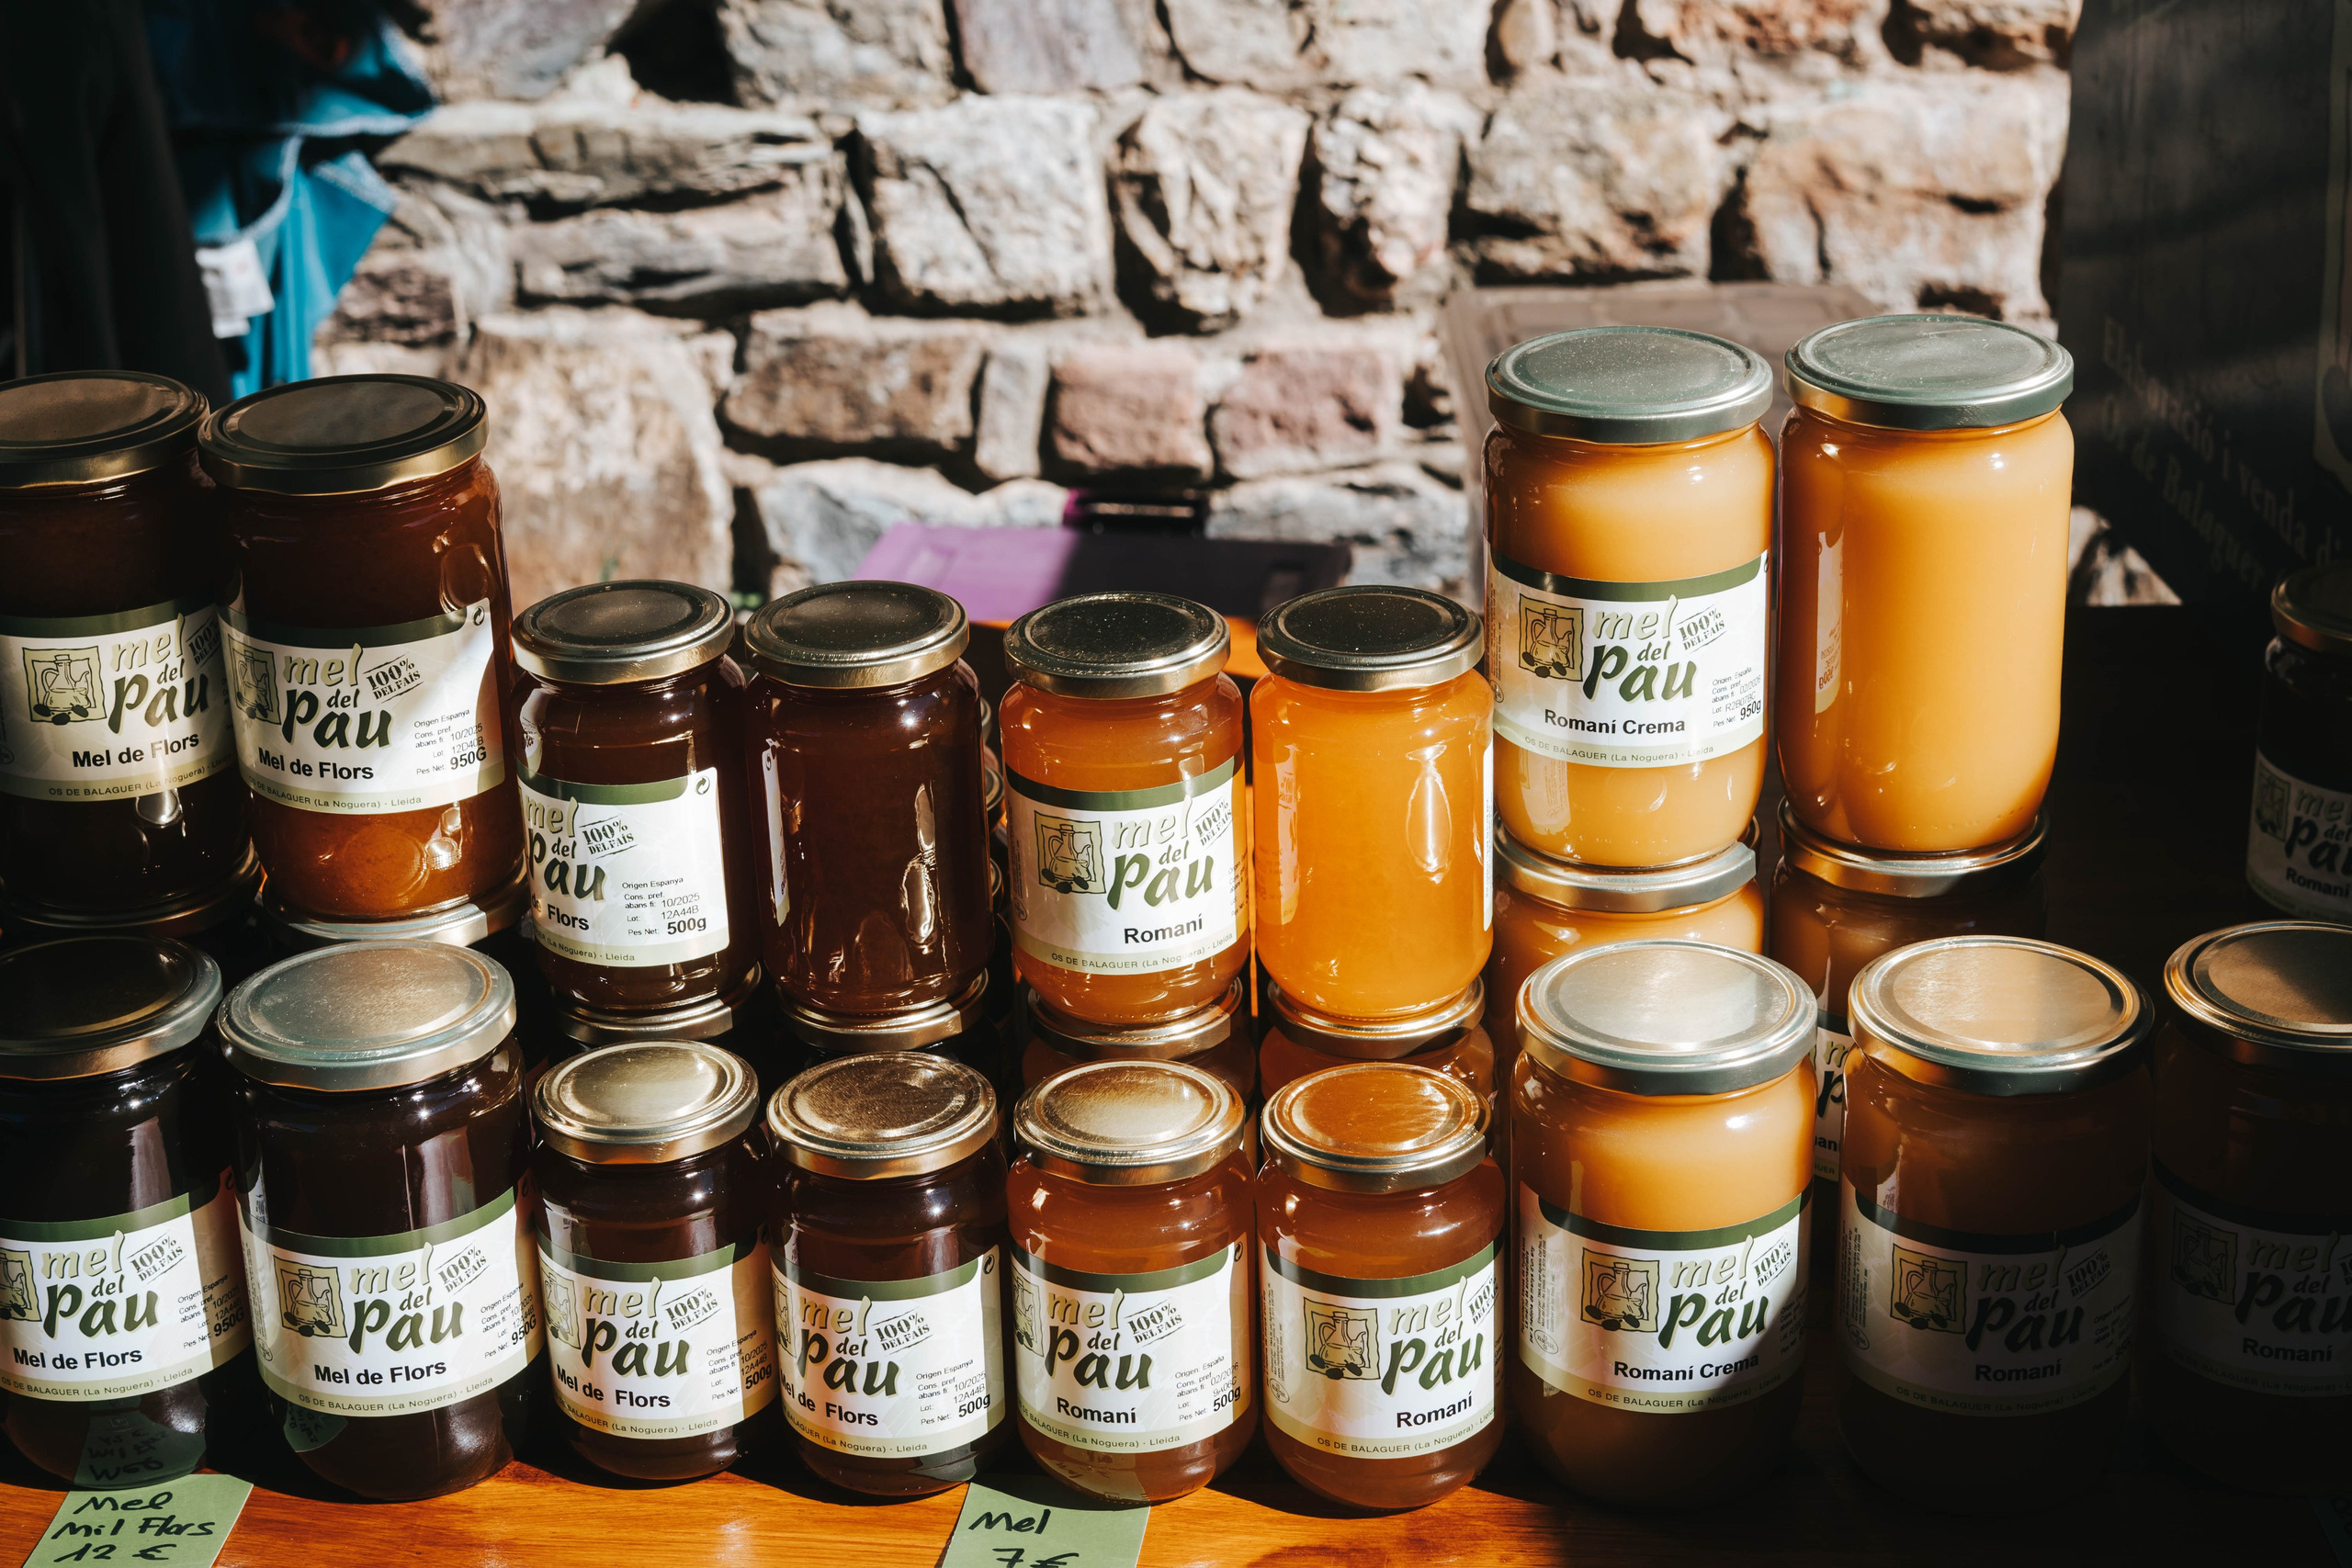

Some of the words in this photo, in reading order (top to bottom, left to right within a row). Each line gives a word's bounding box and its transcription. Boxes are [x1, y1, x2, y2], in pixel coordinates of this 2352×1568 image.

[1591, 594, 1679, 640] mel
[1678, 607, 1723, 641] 100%
[110, 613, 185, 671] mel
[1636, 640, 1671, 661] del
[157, 659, 185, 683] del
[283, 643, 363, 686] mel
[367, 657, 415, 691] 100%
[327, 688, 360, 708] del
[1740, 698, 1762, 721] 950g
[451, 723, 483, 741] 10/2025
[1544, 709, 1617, 735] Romaní
[1622, 720, 1686, 735] Crema
[73, 750, 111, 768] Mel
[119, 747, 144, 764] de
[151, 734, 199, 759] Flors
[450, 746, 488, 770] 950G
[1525, 736, 1536, 747] OS
[1538, 740, 1551, 750] DE
[1553, 745, 1607, 761] BALAGUER
[1631, 751, 1679, 762] Noguera)
[257, 747, 285, 771] Mel
[289, 759, 313, 777] de
[320, 761, 374, 780] Flors
[49, 787, 62, 795] OS
[66, 787, 80, 796] DE
[84, 784, 141, 795] BALAGUER
[266, 786, 311, 805] BALAGUER
[333, 800, 381, 809] Noguera)
[391, 796, 422, 807] Lleida
[526, 796, 579, 838] mel
[1111, 795, 1193, 849] mel
[582, 819, 628, 845] 100%
[551, 837, 577, 859] del
[1159, 840, 1189, 865] del
[622, 882, 649, 890] Origen
[650, 876, 684, 888] Espanya
[625, 901, 649, 909] abans
[662, 892, 700, 908] 10/2025
[662, 905, 699, 920] 12A44B
[548, 904, 589, 931] Flors
[667, 917, 707, 936] 500g
[1124, 913, 1204, 944] Romaní
[605, 953, 635, 962] Lleida
[1052, 953, 1065, 962] OS
[1066, 955, 1079, 965] DE
[1081, 958, 1138, 969] BALAGUER
[41, 1229, 125, 1279] mel
[130, 1236, 177, 1273] 100%
[1668, 1235, 1754, 1289] mel
[349, 1241, 434, 1294] mel
[91, 1274, 125, 1298] del
[202, 1273, 229, 1294] Espanya
[1715, 1281, 1747, 1306] del
[399, 1287, 432, 1312] del
[582, 1277, 662, 1318] mel
[665, 1288, 713, 1322] 100%
[1047, 1288, 1125, 1330] mel
[1388, 1275, 1468, 1335] mel
[2024, 1289, 2058, 1313] del
[799, 1295, 872, 1337] mel
[875, 1312, 925, 1341] 100%
[1127, 1302, 1177, 1336] 100%
[511, 1314, 537, 1346] 950G
[625, 1321, 658, 1339] del
[1087, 1330, 1121, 1351] del
[1434, 1320, 1464, 1349] del
[13, 1347, 46, 1369] Mel
[51, 1353, 79, 1371] de
[85, 1349, 142, 1369] Flors
[706, 1344, 731, 1356] Origen
[741, 1342, 768, 1364] 10/2025
[835, 1337, 868, 1357] del
[2243, 1337, 2332, 1362] Romaní
[314, 1364, 349, 1384] Mel
[356, 1367, 383, 1385] de
[390, 1361, 447, 1383] Flors
[745, 1365, 773, 1390] 500g
[916, 1371, 942, 1381] Origen
[944, 1359, 974, 1376] Espanya
[1614, 1360, 1693, 1382] Romaní
[1699, 1354, 1758, 1378] Crema
[1975, 1359, 2061, 1382] Romaní
[13, 1381, 26, 1391] DE
[27, 1384, 80, 1396] BALAGUER
[104, 1379, 154, 1395] Noguera)
[164, 1368, 194, 1383] Lleida
[299, 1393, 311, 1404] OS
[312, 1397, 325, 1407] DE
[328, 1401, 384, 1412] BALAGUER
[409, 1390, 457, 1408] Noguera)
[466, 1377, 493, 1393] Lleida
[556, 1364, 579, 1392] Mel
[582, 1382, 605, 1402] de
[615, 1389, 671, 1407] Flors
[919, 1389, 941, 1400] abans
[954, 1371, 987, 1393] 10/2025
[953, 1382, 986, 1404] 12A44B
[1176, 1386, 1198, 1398] abans
[797, 1391, 816, 1412] de
[826, 1402, 878, 1427] Flors
[921, 1416, 935, 1426] Pes
[957, 1393, 991, 1418] 500g
[1057, 1396, 1136, 1424] Romaní
[1179, 1412, 1193, 1422] Pes
[1214, 1385, 1241, 1412] 500g
[1396, 1391, 1474, 1428] Romaní
[1589, 1388, 1600, 1397] OS
[1605, 1393, 1620, 1403] DE
[1623, 1396, 1683, 1408] BALAGUER
[1913, 1391, 1928, 1402] DE
[1930, 1395, 1991, 1411] BALAGUER
[630, 1425, 678, 1435] Noguera)
[688, 1418, 718, 1430] Lleida
[1029, 1411, 1069, 1439] BALAGUER
[1091, 1437, 1139, 1449] Noguera)
[1149, 1434, 1181, 1446] Lleida
[840, 1439, 886, 1454] Noguera)
[897, 1442, 928, 1452] Lleida
[1317, 1437, 1331, 1447] OS
[1333, 1441, 1348, 1451] DE
[1351, 1443, 1410, 1453] BALAGUER
[74, 1491, 174, 1515] Mel
[51, 1518, 126, 1540] Mil
[967, 1508, 1052, 1534] Mel
[53, 1543, 117, 1562] 12
[132, 1544, 177, 1561] €
[991, 1548, 1025, 1568] 7
